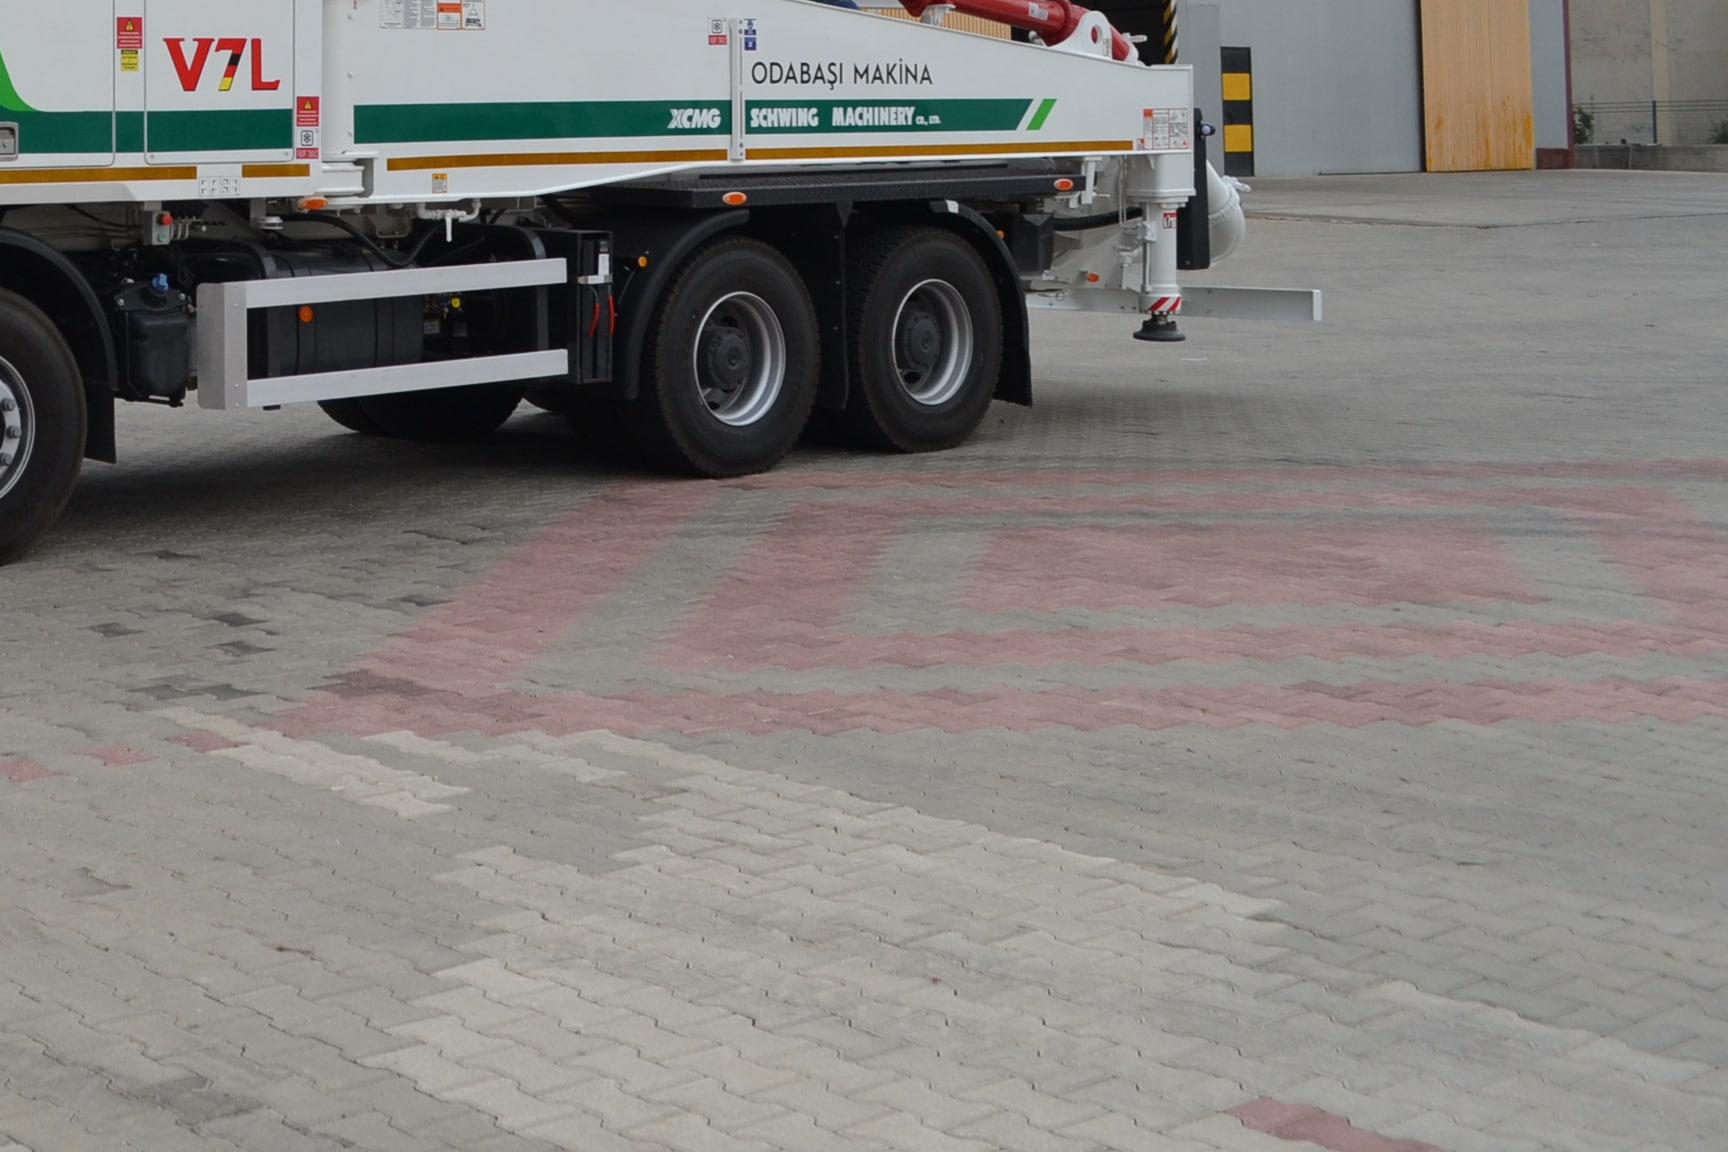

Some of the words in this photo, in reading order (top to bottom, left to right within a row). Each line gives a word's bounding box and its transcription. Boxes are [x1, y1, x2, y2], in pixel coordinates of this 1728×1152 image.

[163, 38, 281, 92] V7L
[751, 61, 843, 90] ODABAŞI
[853, 58, 933, 85] MAKİNA
[667, 108, 722, 129] XCMG
[750, 107, 819, 127] SCHWING
[832, 106, 915, 127] MACHINERY
